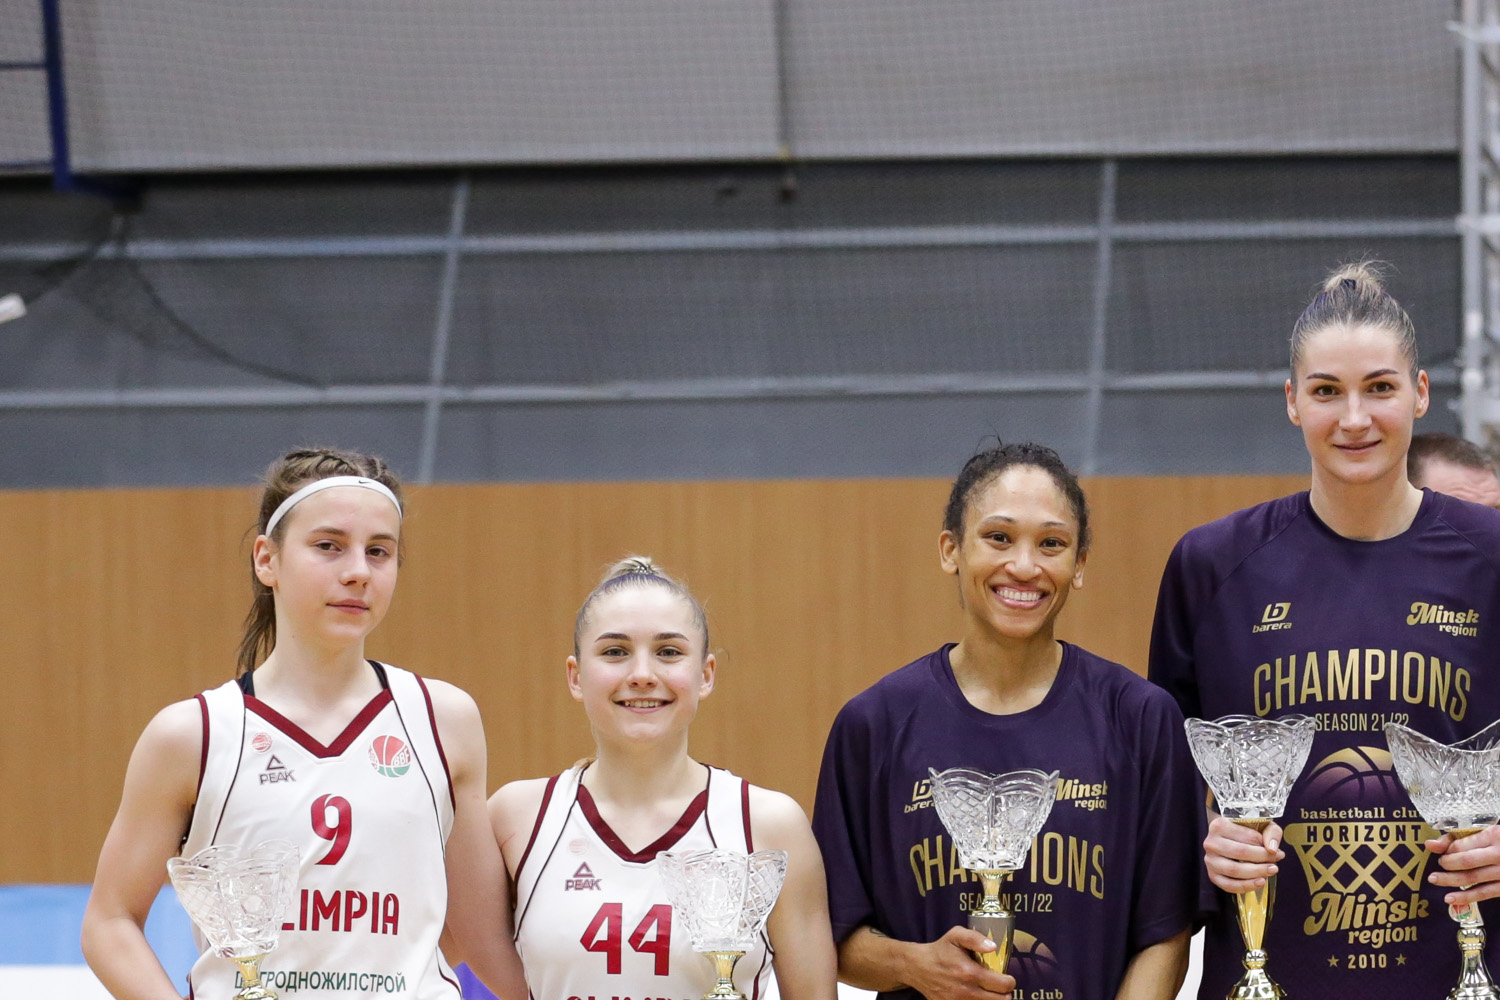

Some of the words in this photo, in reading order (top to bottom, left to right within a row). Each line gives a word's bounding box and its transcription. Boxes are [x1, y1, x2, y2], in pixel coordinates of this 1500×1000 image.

[1406, 601, 1480, 626] Minsk
[1252, 621, 1293, 634] barera
[1438, 623, 1478, 637] region
[1253, 648, 1472, 722] CHAMPIONS
[1315, 712, 1368, 732] SEASON
[259, 769, 296, 786] PEAK
[1074, 797, 1108, 812] regio
[1300, 807, 1386, 819] basketball
[1393, 807, 1422, 819] clu
[310, 793, 353, 866] 9
[1306, 825, 1422, 843] HORIZONT
[909, 832, 1105, 900] CHAIONS
[564, 878, 602, 892] PEAK
[1303, 892, 1430, 936] Minsk
[579, 902, 673, 976] 44
[1348, 922, 1418, 949] region
[1347, 953, 1388, 969] 2010
[259, 971, 407, 993] ГРОДНОЖИЛСТРОЙ
[1031, 988, 1064, 1000] club
